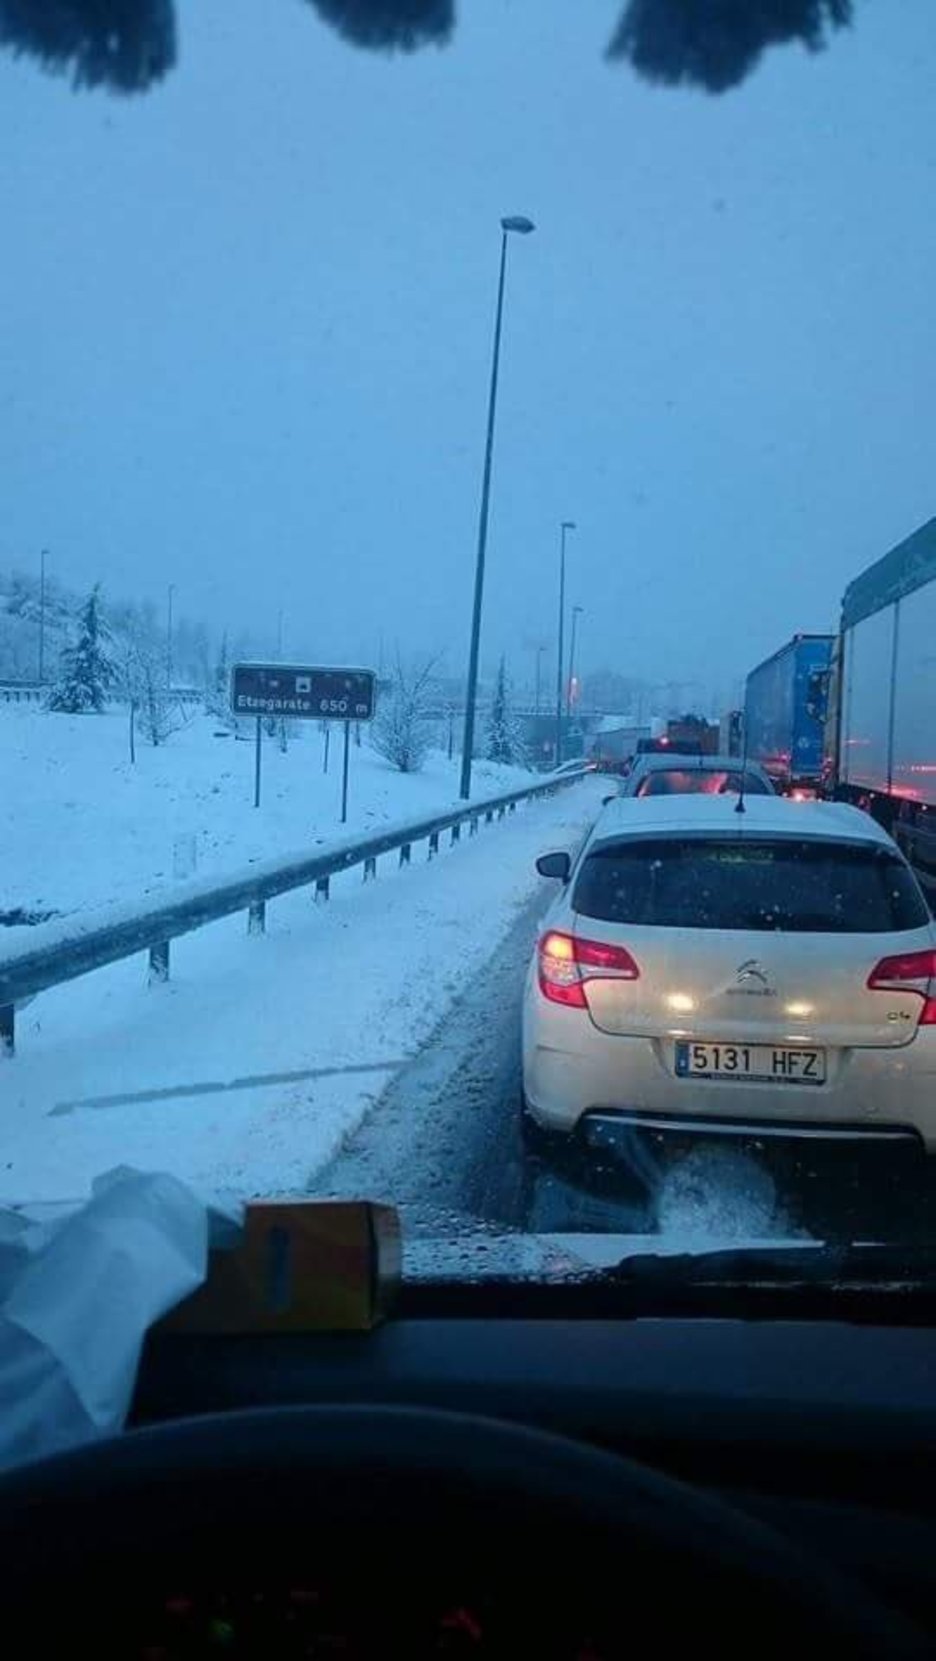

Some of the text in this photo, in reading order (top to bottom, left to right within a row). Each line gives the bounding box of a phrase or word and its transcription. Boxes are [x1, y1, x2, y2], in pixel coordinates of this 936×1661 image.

[319, 698, 348, 712] 650
[355, 703, 369, 714] m
[693, 1046, 818, 1076] 5131 HFZ
